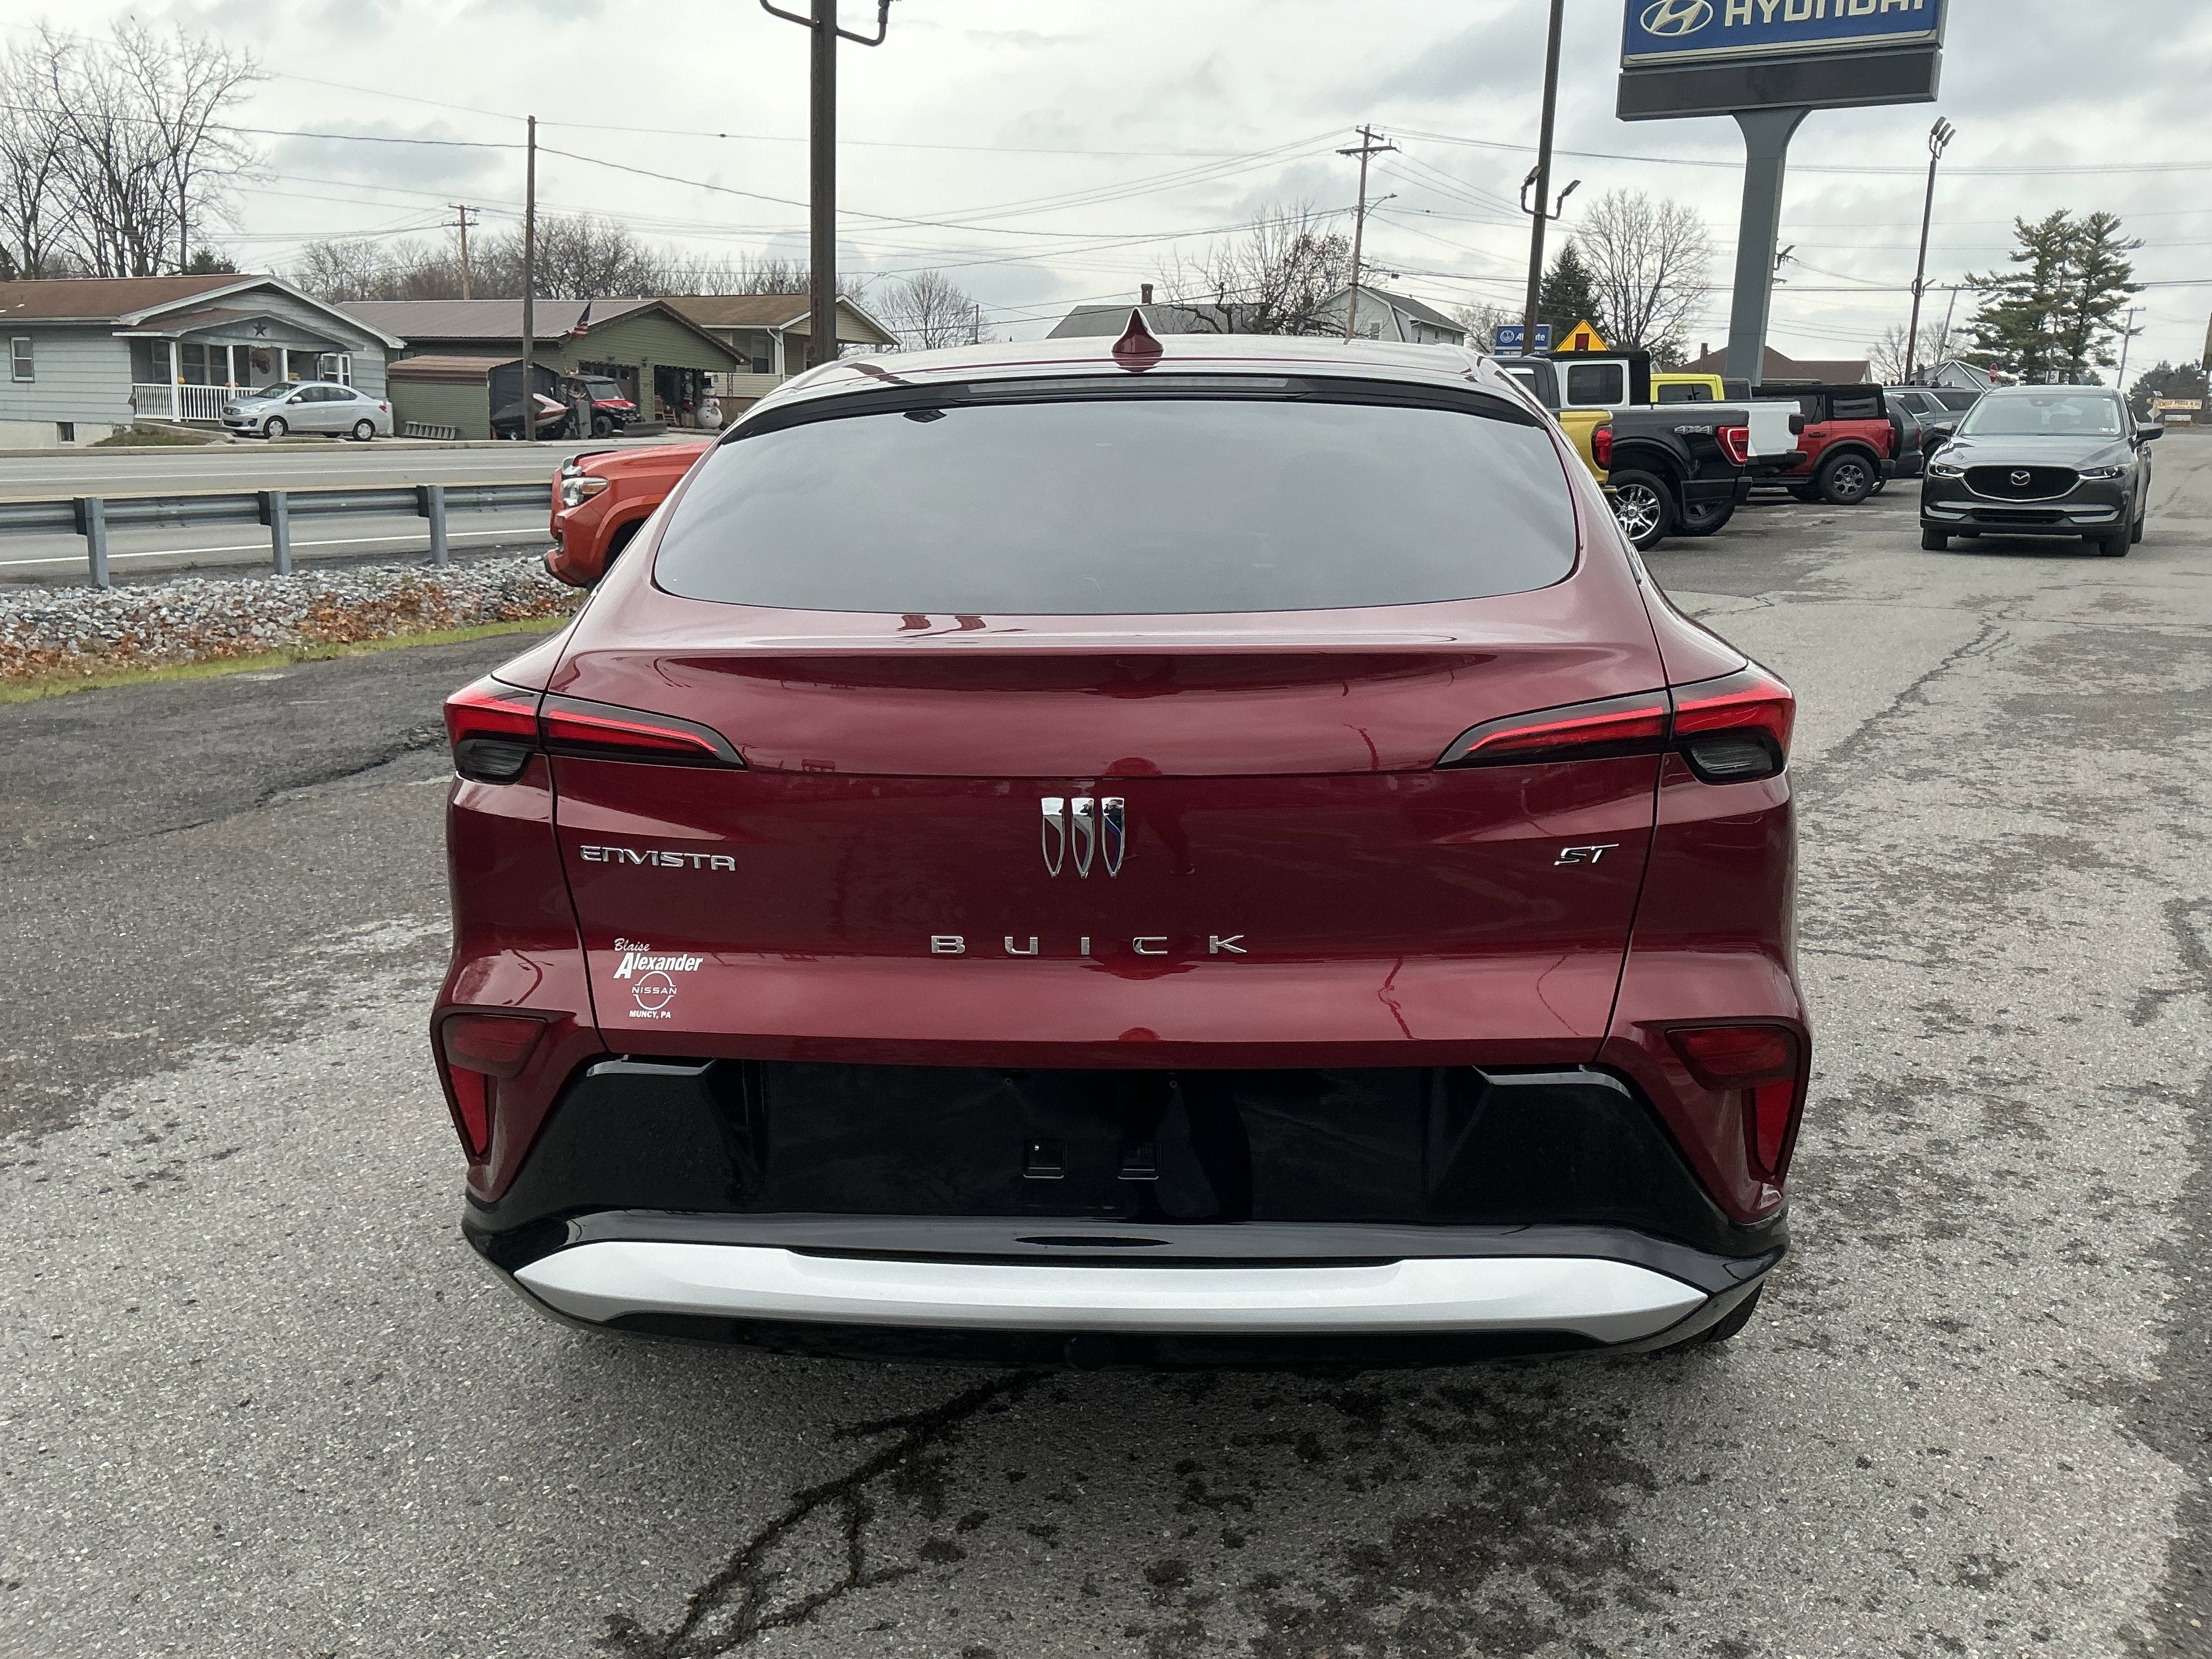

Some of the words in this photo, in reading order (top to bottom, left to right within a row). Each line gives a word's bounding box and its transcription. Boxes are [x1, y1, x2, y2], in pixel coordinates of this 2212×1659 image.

[580, 845, 736, 871] ENVISTA
[1554, 843, 1620, 866] ST
[613, 938, 651, 952] Blaise
[930, 935, 1248, 955] BUICK
[613, 952, 704, 979] Alexander
[631, 986, 678, 995] NISSAN
[629, 1010, 658, 1020] MUNCY,
[660, 1011, 672, 1019] PA
